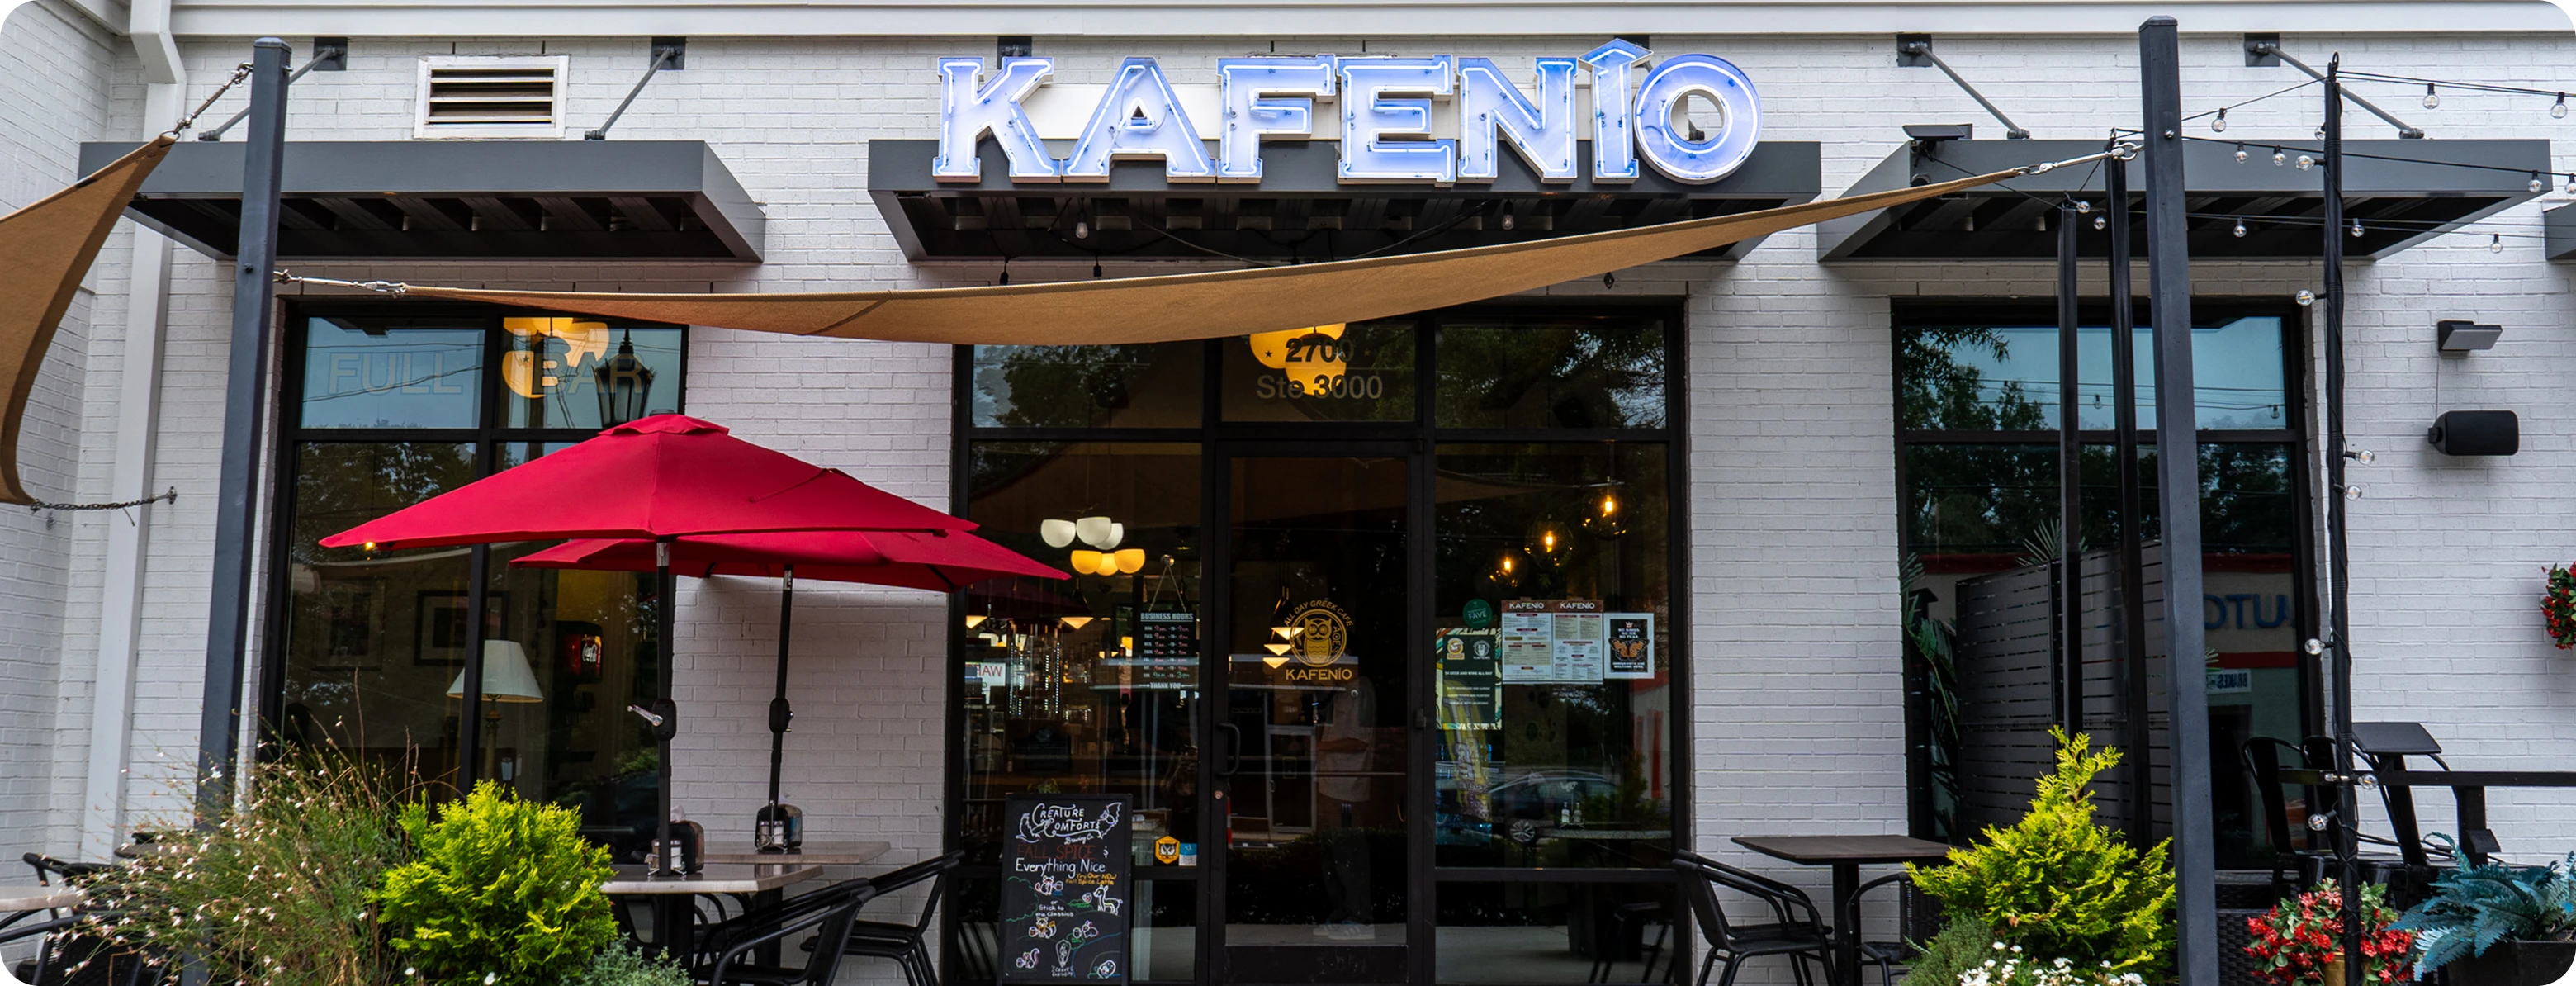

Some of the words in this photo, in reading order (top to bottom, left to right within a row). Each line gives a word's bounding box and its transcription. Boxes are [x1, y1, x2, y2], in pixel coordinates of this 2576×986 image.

[1285, 338, 1354, 363] 2700
[328, 351, 464, 396] FULL
[532, 351, 647, 396] BAR
[1257, 375, 1305, 399] Ste
[1314, 374, 1383, 400] 3000
[1140, 612, 1171, 620] BUSINESS
[1172, 612, 1194, 620] HOURS
[1284, 613, 1296, 627] ALL
[1294, 602, 1309, 614] DAY
[1309, 599, 1338, 611] GREEK
[1468, 610, 1488, 620] FAVE
[1285, 666, 1353, 680] KAFENÍO
[1016, 844, 1050, 859] FALL
[1055, 844, 1097, 860] SPICE
[1016, 857, 1076, 879] Everything
[1080, 859, 1106, 872] Nice
